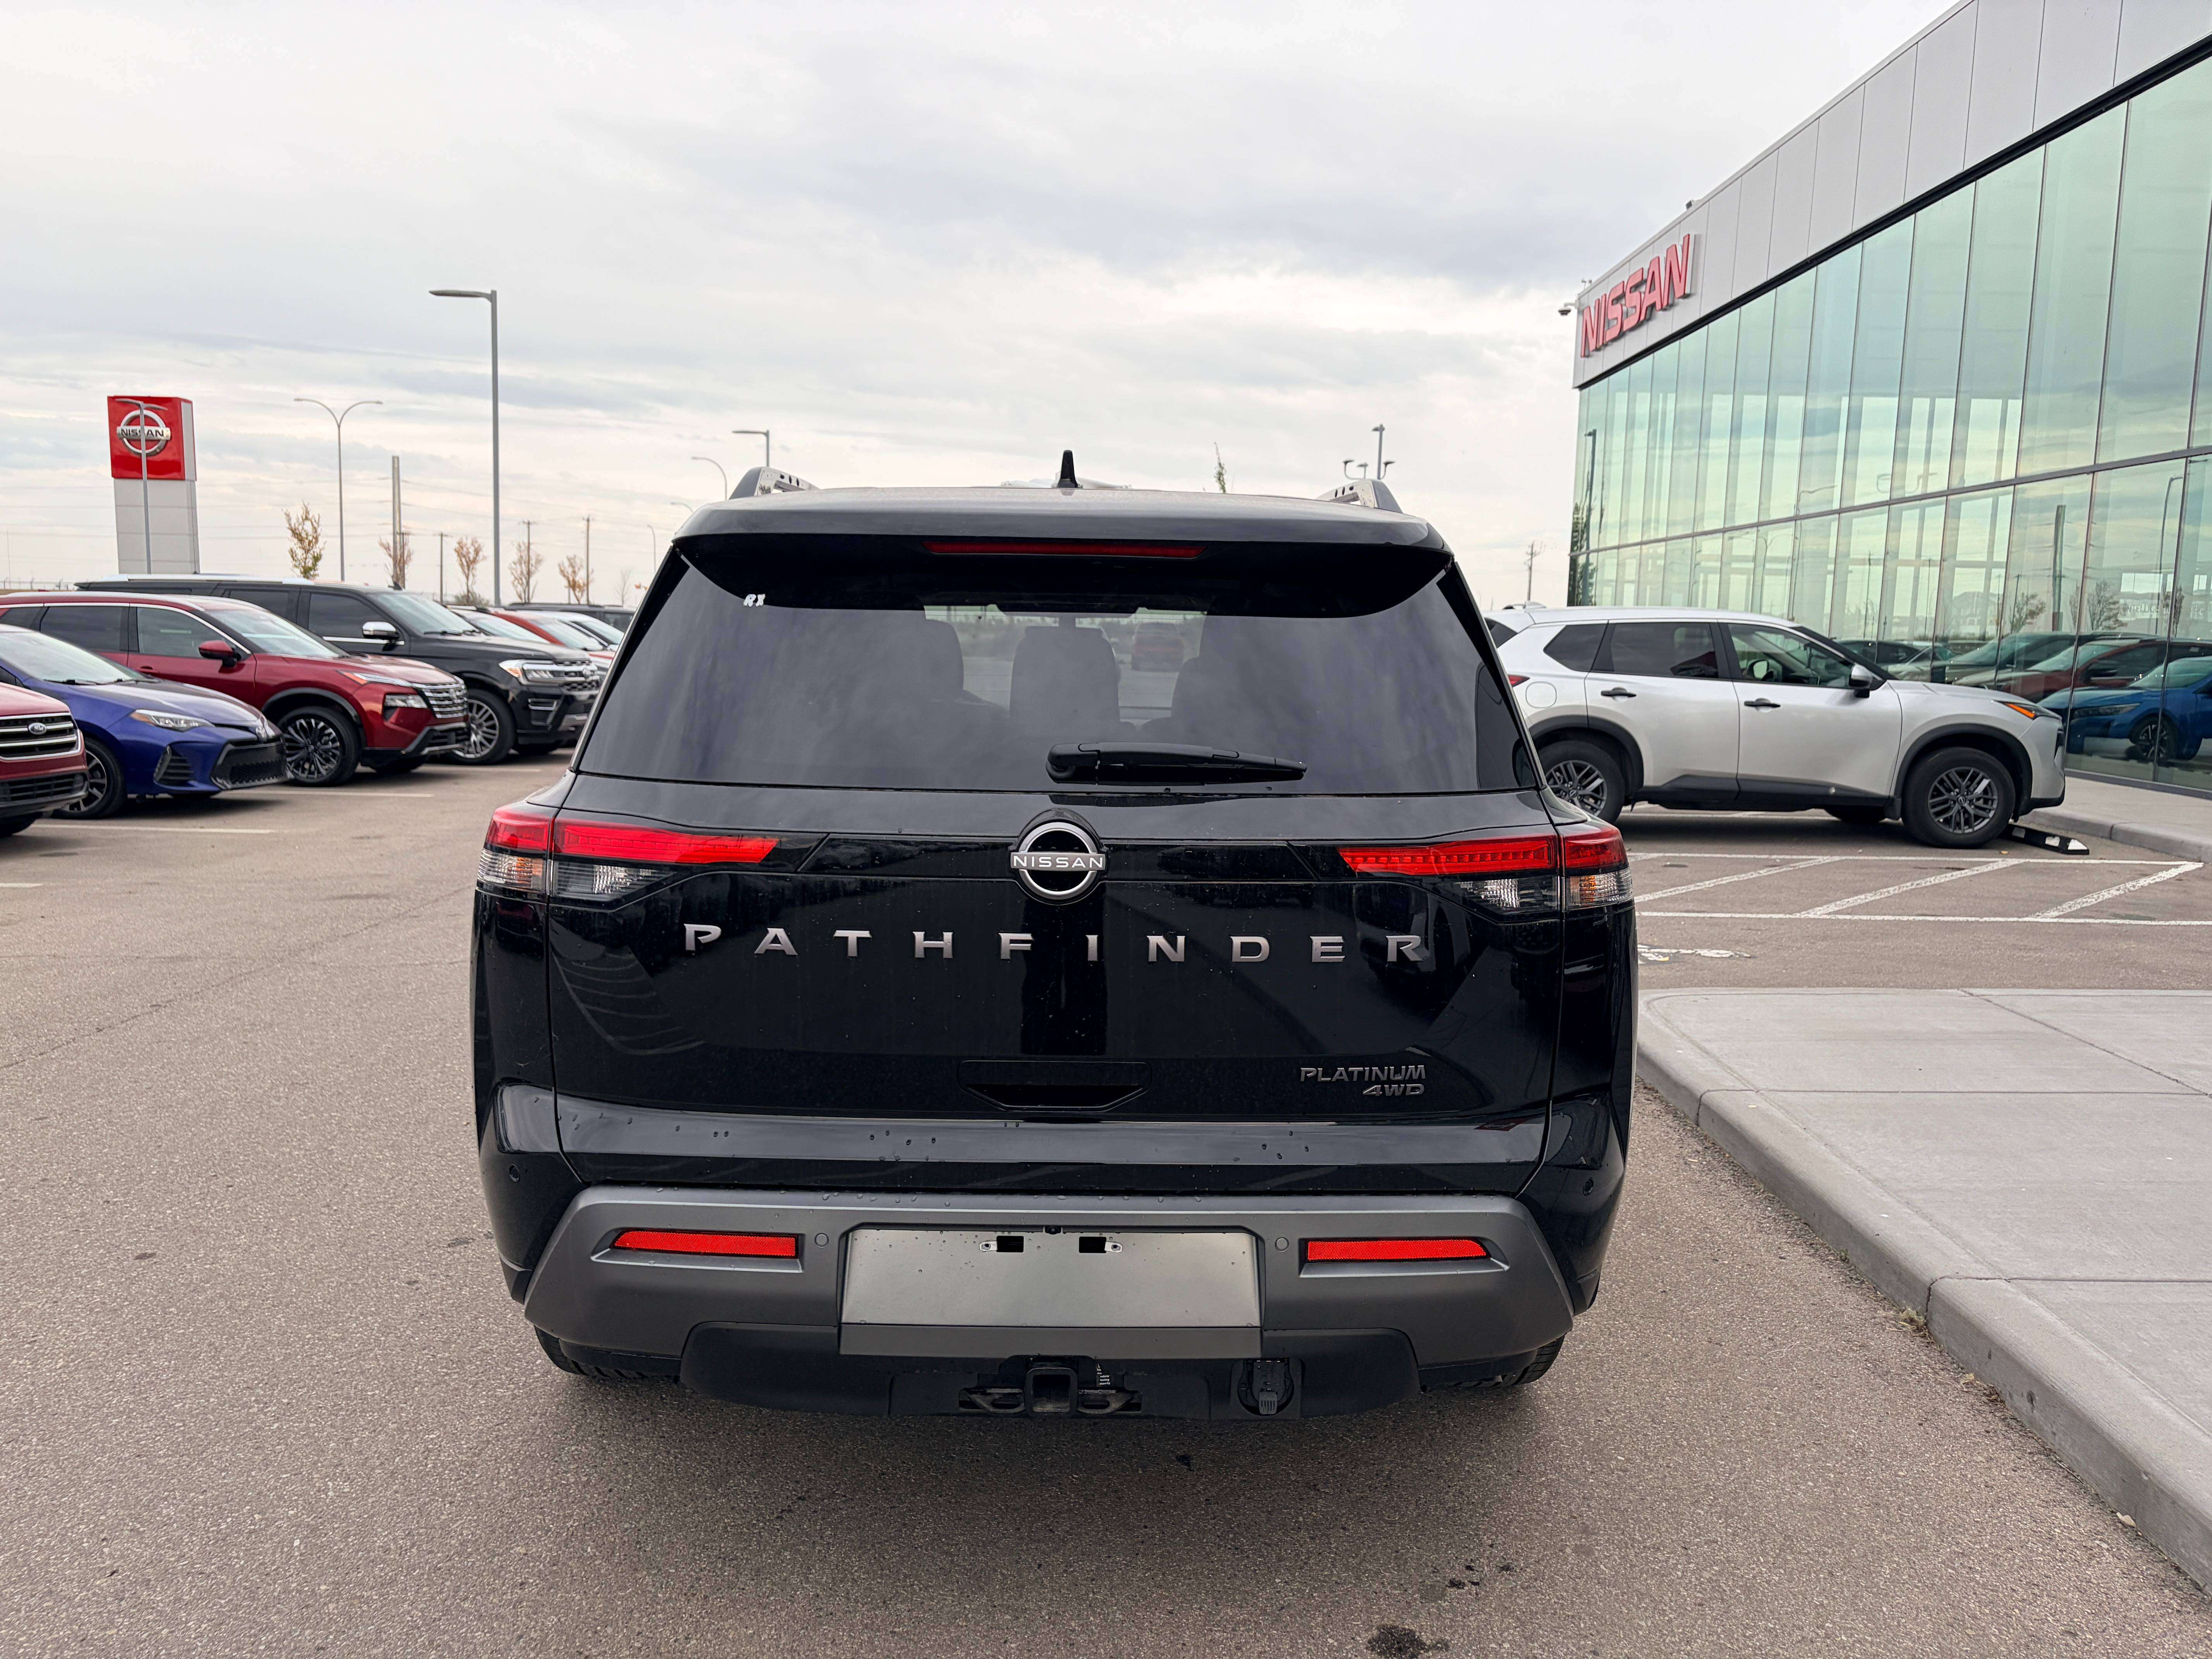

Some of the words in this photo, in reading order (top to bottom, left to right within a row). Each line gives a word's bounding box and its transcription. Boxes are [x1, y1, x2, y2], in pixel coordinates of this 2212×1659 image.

[1580, 234, 1690, 357] NISSAN
[121, 429, 164, 437] NISAN
[1013, 855, 1103, 868] NISSAN
[684, 923, 1424, 963] PATHFINDER
[1300, 1065, 1426, 1082] PLATINUM
[1363, 1084, 1425, 1096] 4WD
